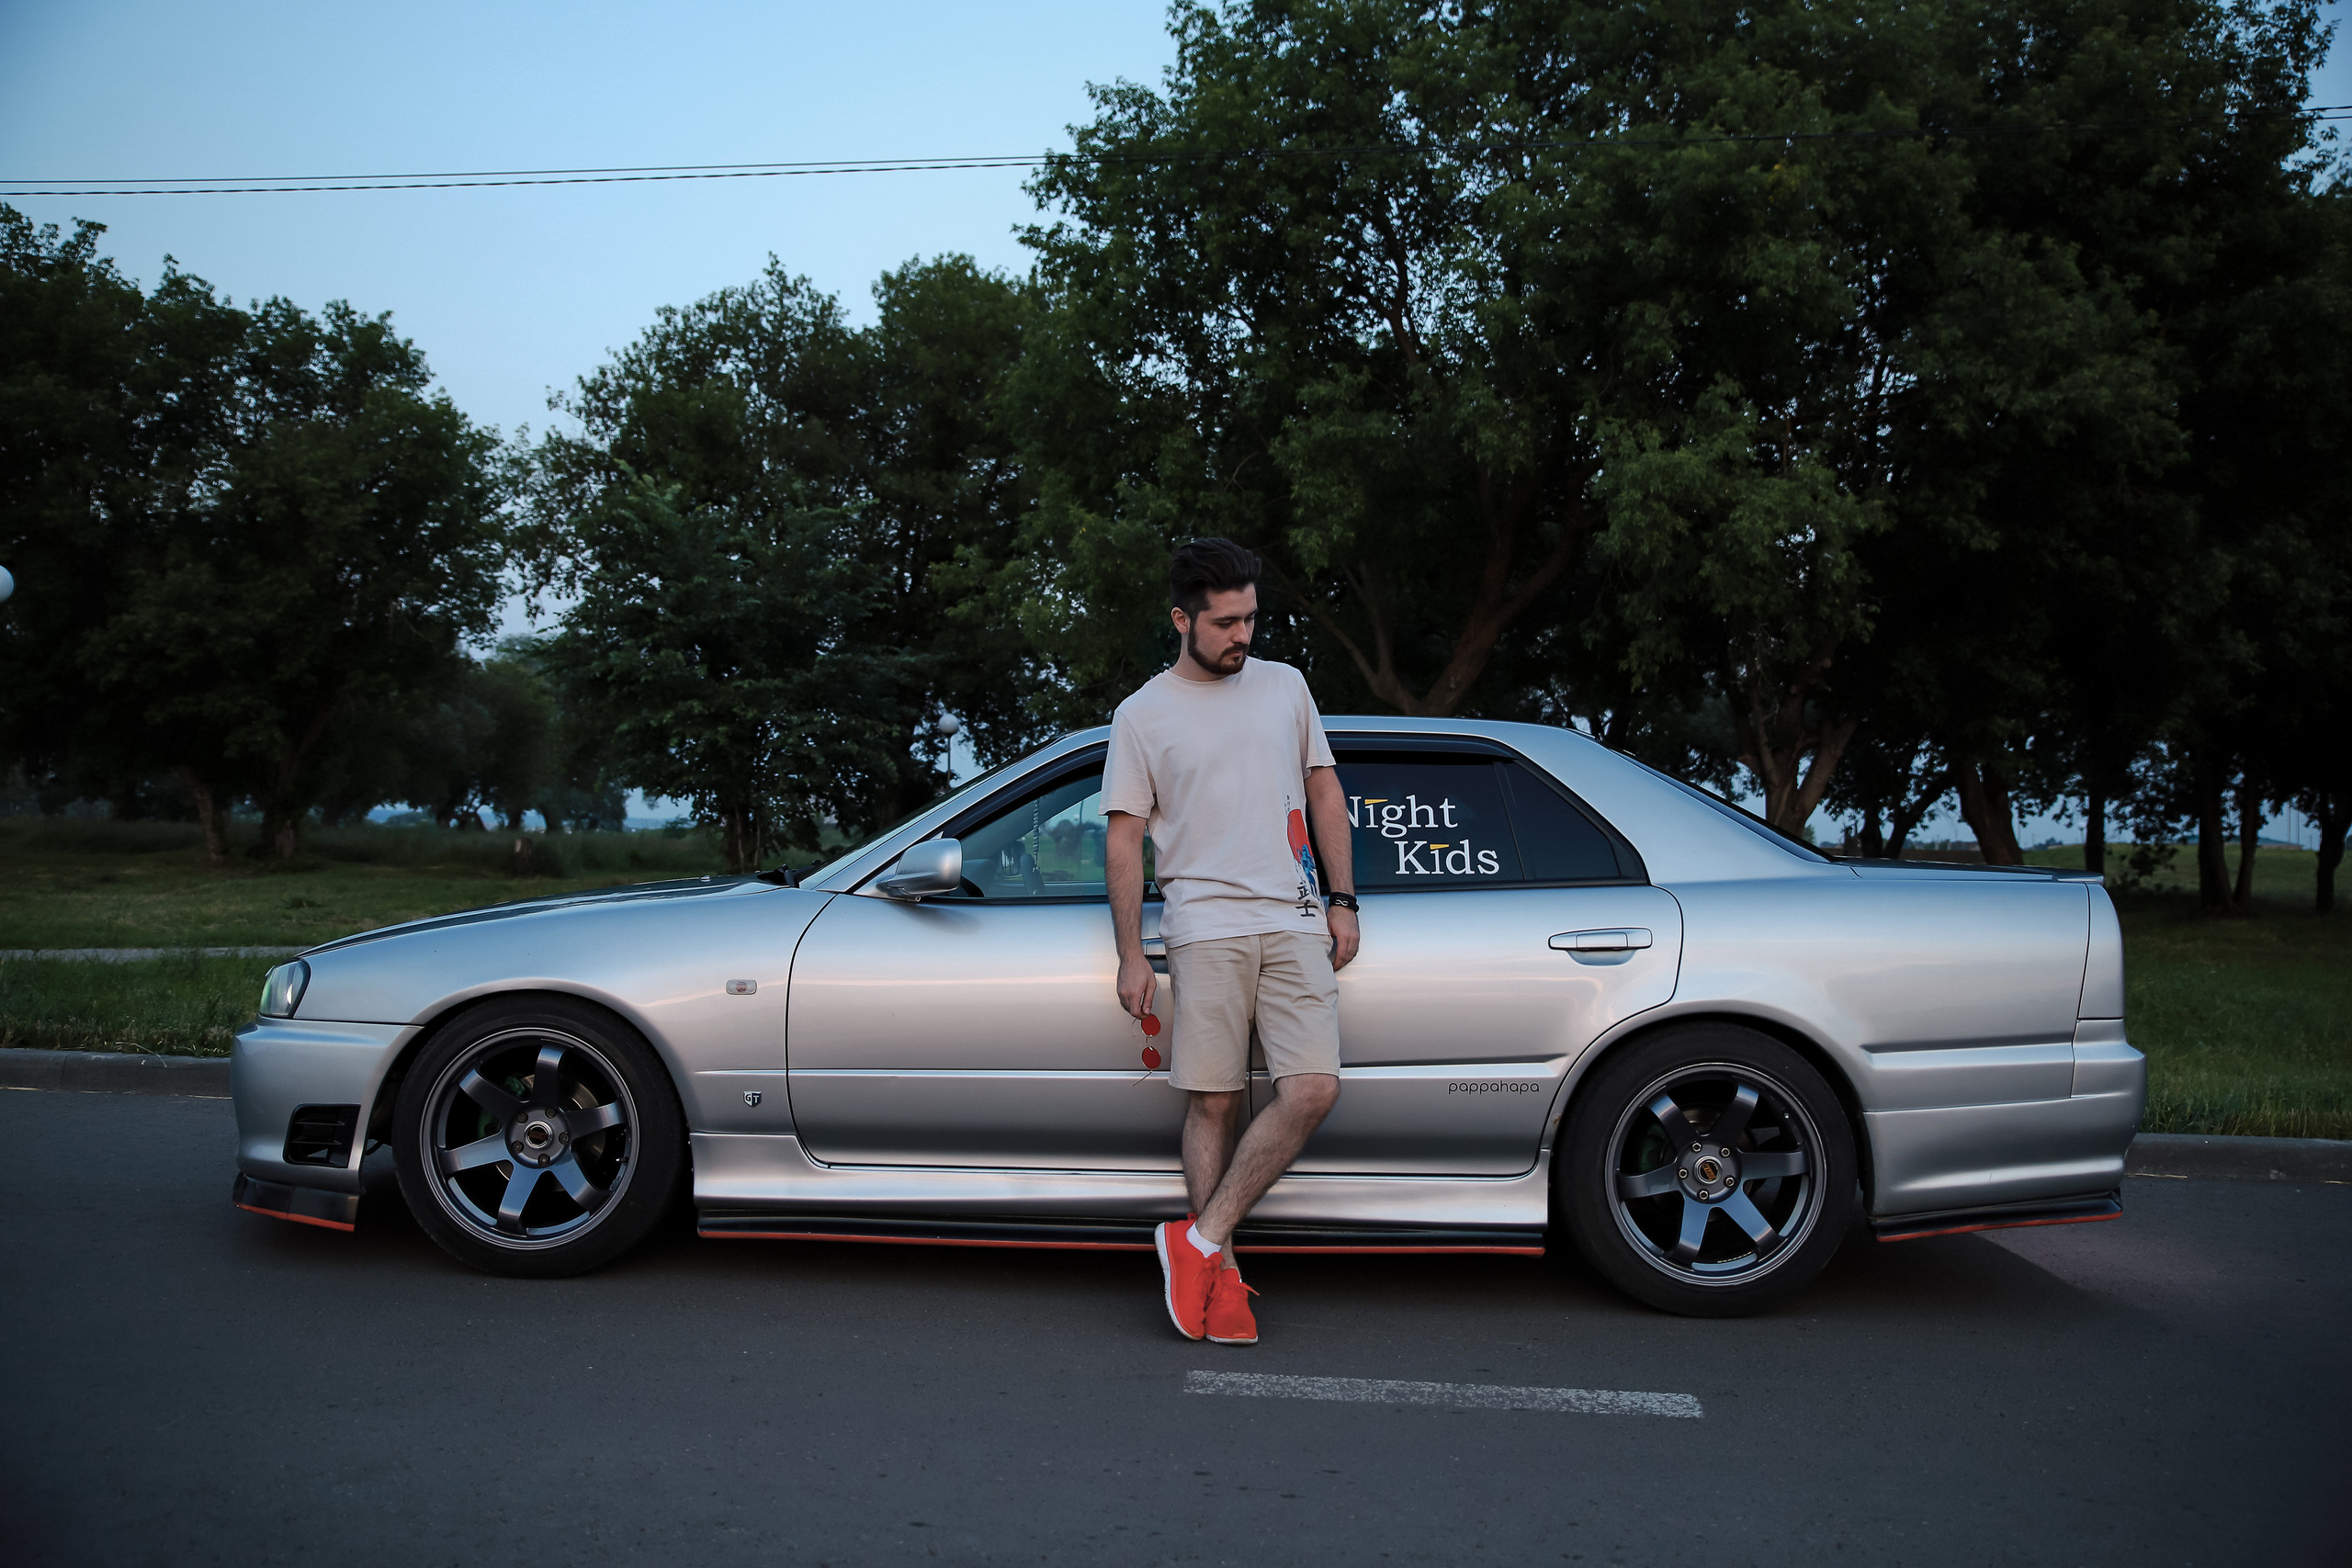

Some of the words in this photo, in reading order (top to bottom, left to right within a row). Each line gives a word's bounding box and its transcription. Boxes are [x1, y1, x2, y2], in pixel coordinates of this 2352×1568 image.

[1394, 840, 1499, 874] Kids
[1448, 1080, 1540, 1095] pappahapa
[745, 1093, 760, 1103] GT
